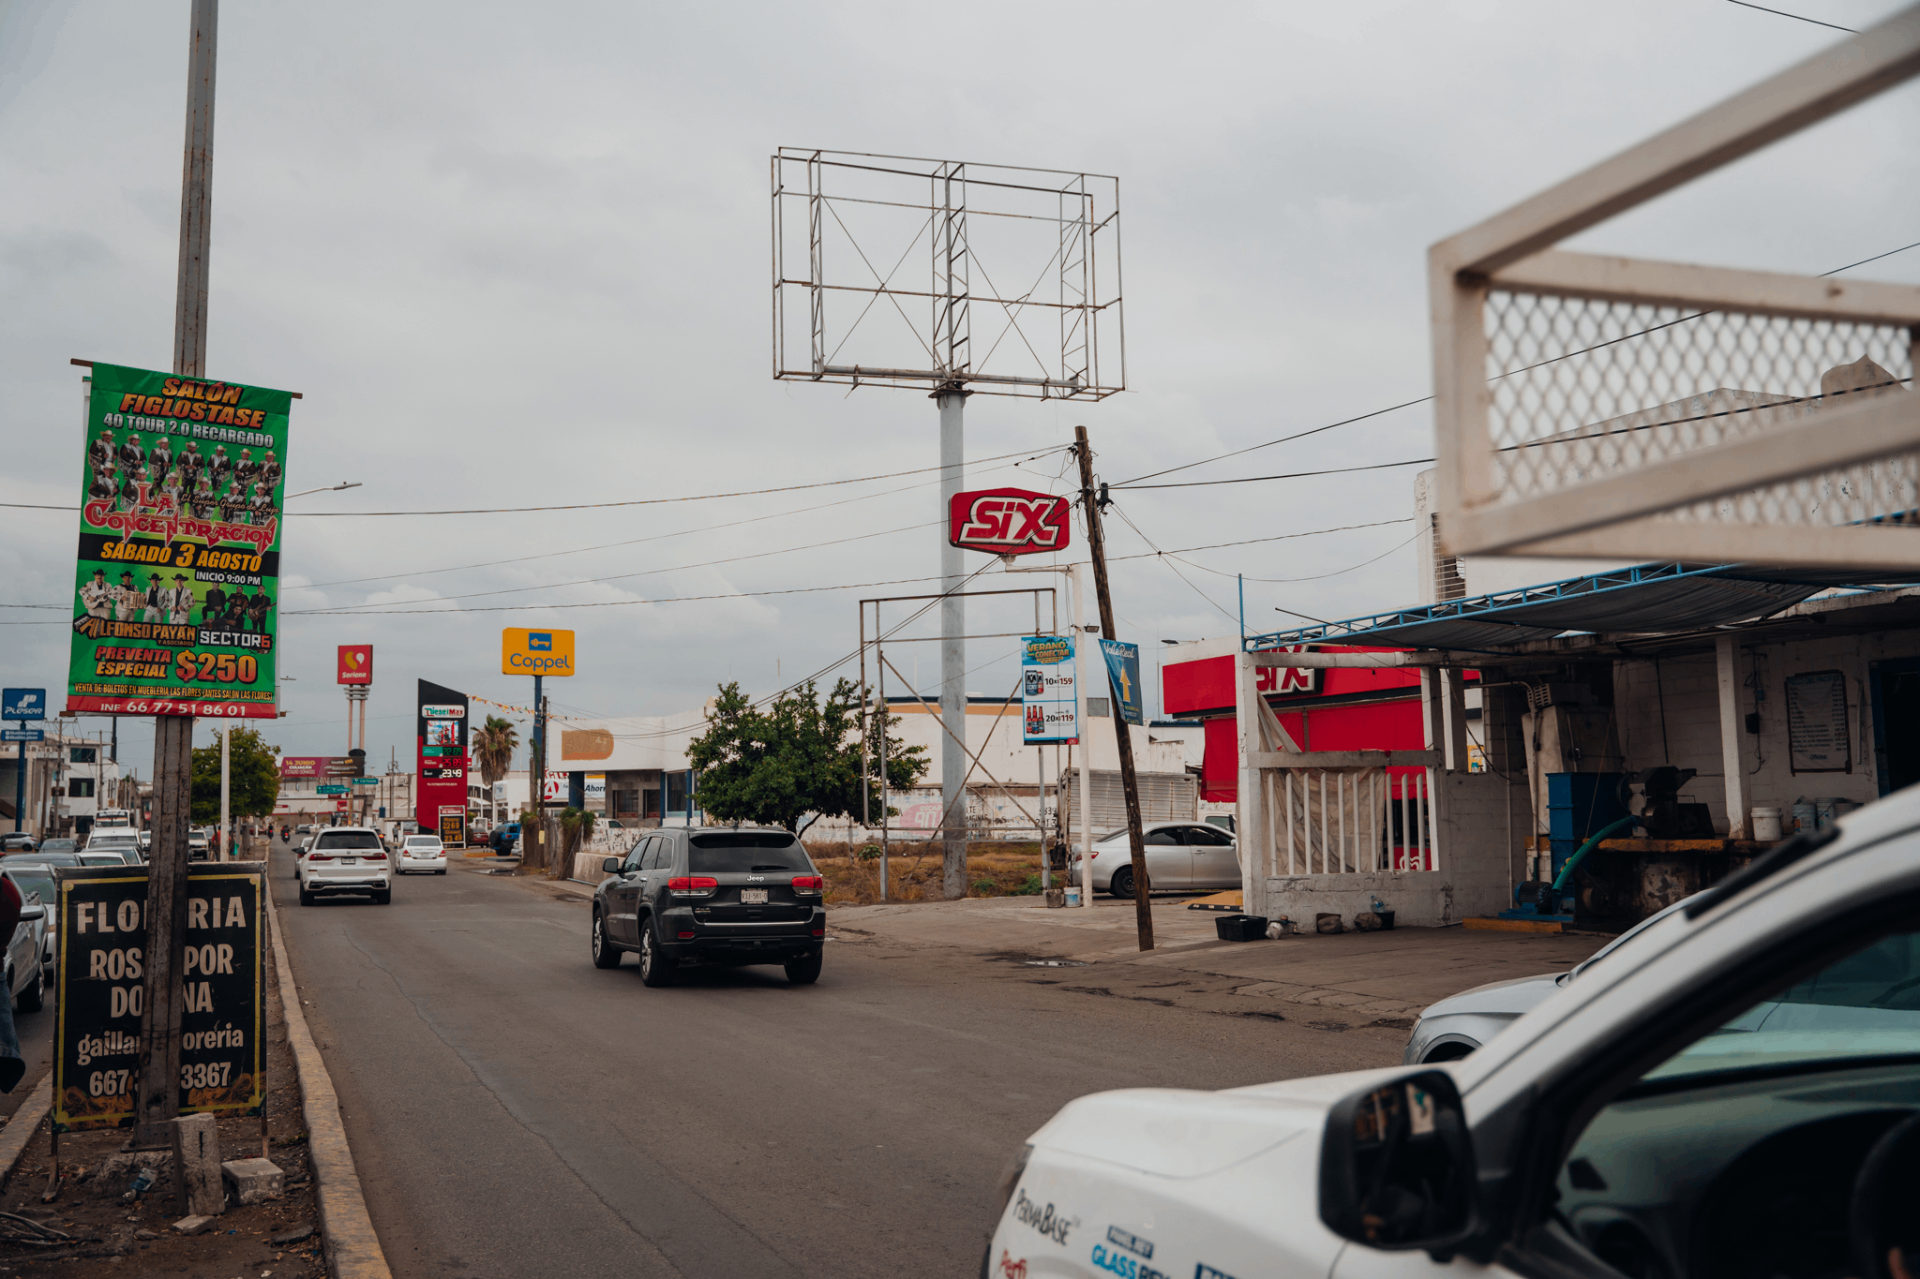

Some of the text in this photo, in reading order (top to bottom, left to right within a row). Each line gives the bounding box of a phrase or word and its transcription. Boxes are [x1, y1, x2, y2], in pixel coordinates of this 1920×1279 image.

[162, 377, 243, 405] SALÓN
[119, 393, 266, 428] FIGLOSTASE
[103, 412, 274, 448] 40 TOUR 2.0 RECARGADO
[136, 482, 176, 515] LA
[181, 493, 191, 502] El
[192, 495, 218, 506] Super
[220, 498, 245, 510] Grupo
[259, 504, 279, 515] Lujo
[100, 540, 262, 573] SÁBADO 3 AGOSTO
[196, 571, 261, 585] INICIO 9:00 PM
[79, 617, 151, 640] ALFONSO
[95, 646, 171, 663] PREVENTA
[1027, 641, 1066, 652] VERANO
[1035, 649, 1069, 659] CONECTAR
[1119, 644, 1135, 658] Real
[96, 650, 257, 683] ESPECIAL $250
[510, 653, 570, 672] Coppel
[342, 671, 367, 679] Soriana
[74, 682, 93, 693] VENTA
[94, 683, 102, 692] DE
[103, 684, 128, 694] BOLETOS
[129, 685, 137, 694] EN
[138, 685, 168, 696] MUEBLERIA
[170, 687, 180, 696] LAS
[182, 688, 201, 697] FLORES
[241, 690, 250, 699] LAS
[251, 691, 273, 701] FLORES)
[101, 701, 246, 716] INF 66 77 51 86 01
[77, 896, 247, 934] FLORIA
[90, 943, 234, 981] ROS POR
[110, 981, 214, 1019] DONA
[1092, 1244, 1137, 1279] GLASS
